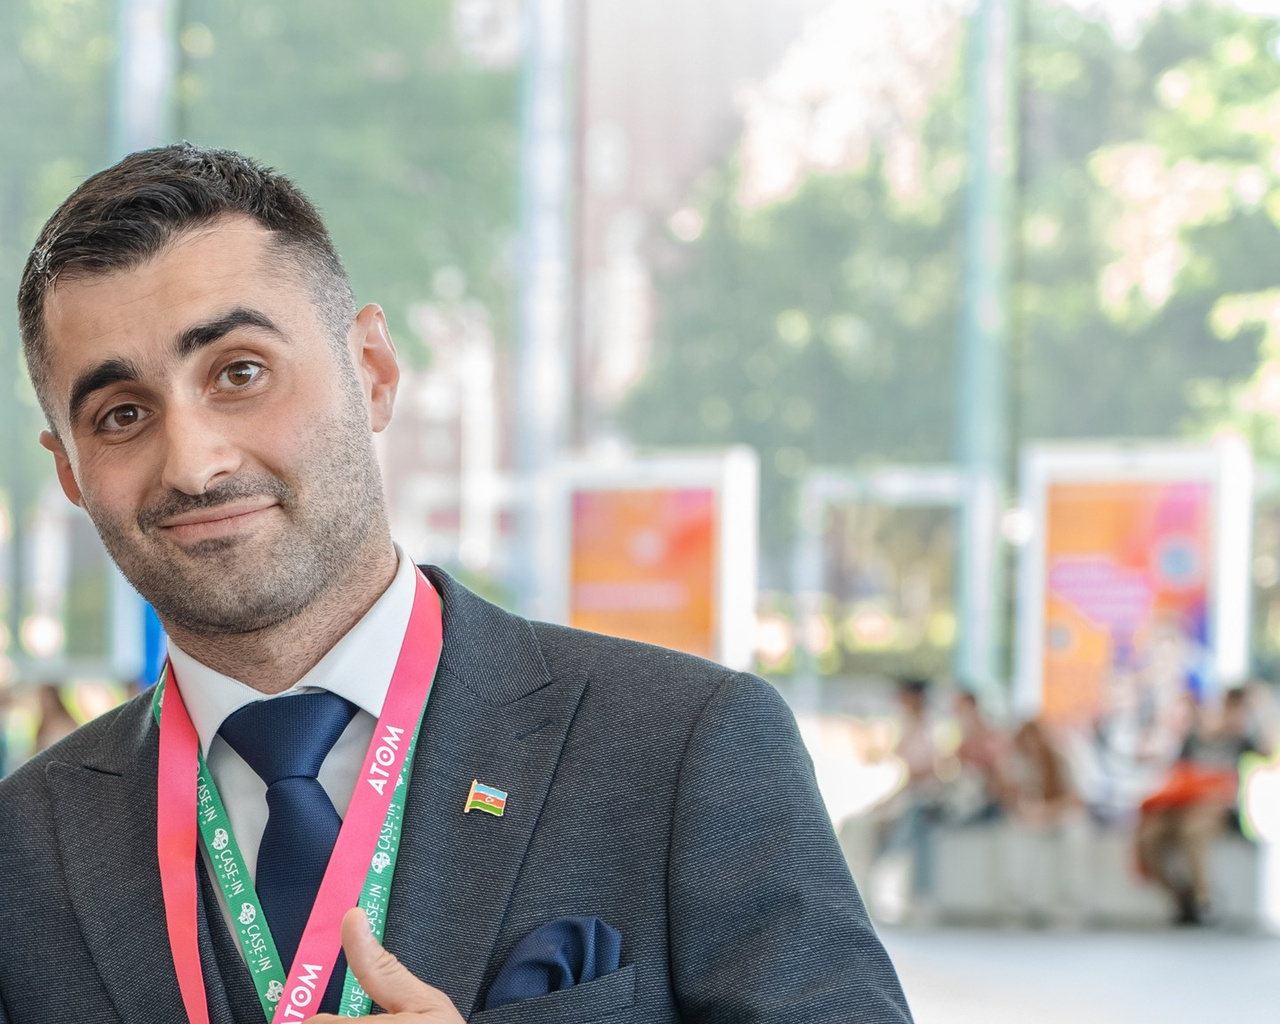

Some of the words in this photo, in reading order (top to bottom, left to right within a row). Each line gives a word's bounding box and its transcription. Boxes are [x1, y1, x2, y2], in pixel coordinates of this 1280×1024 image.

[367, 725, 404, 796] ATOM
[220, 849, 245, 896] CASE-IN
[247, 924, 272, 972] CASE-IN
